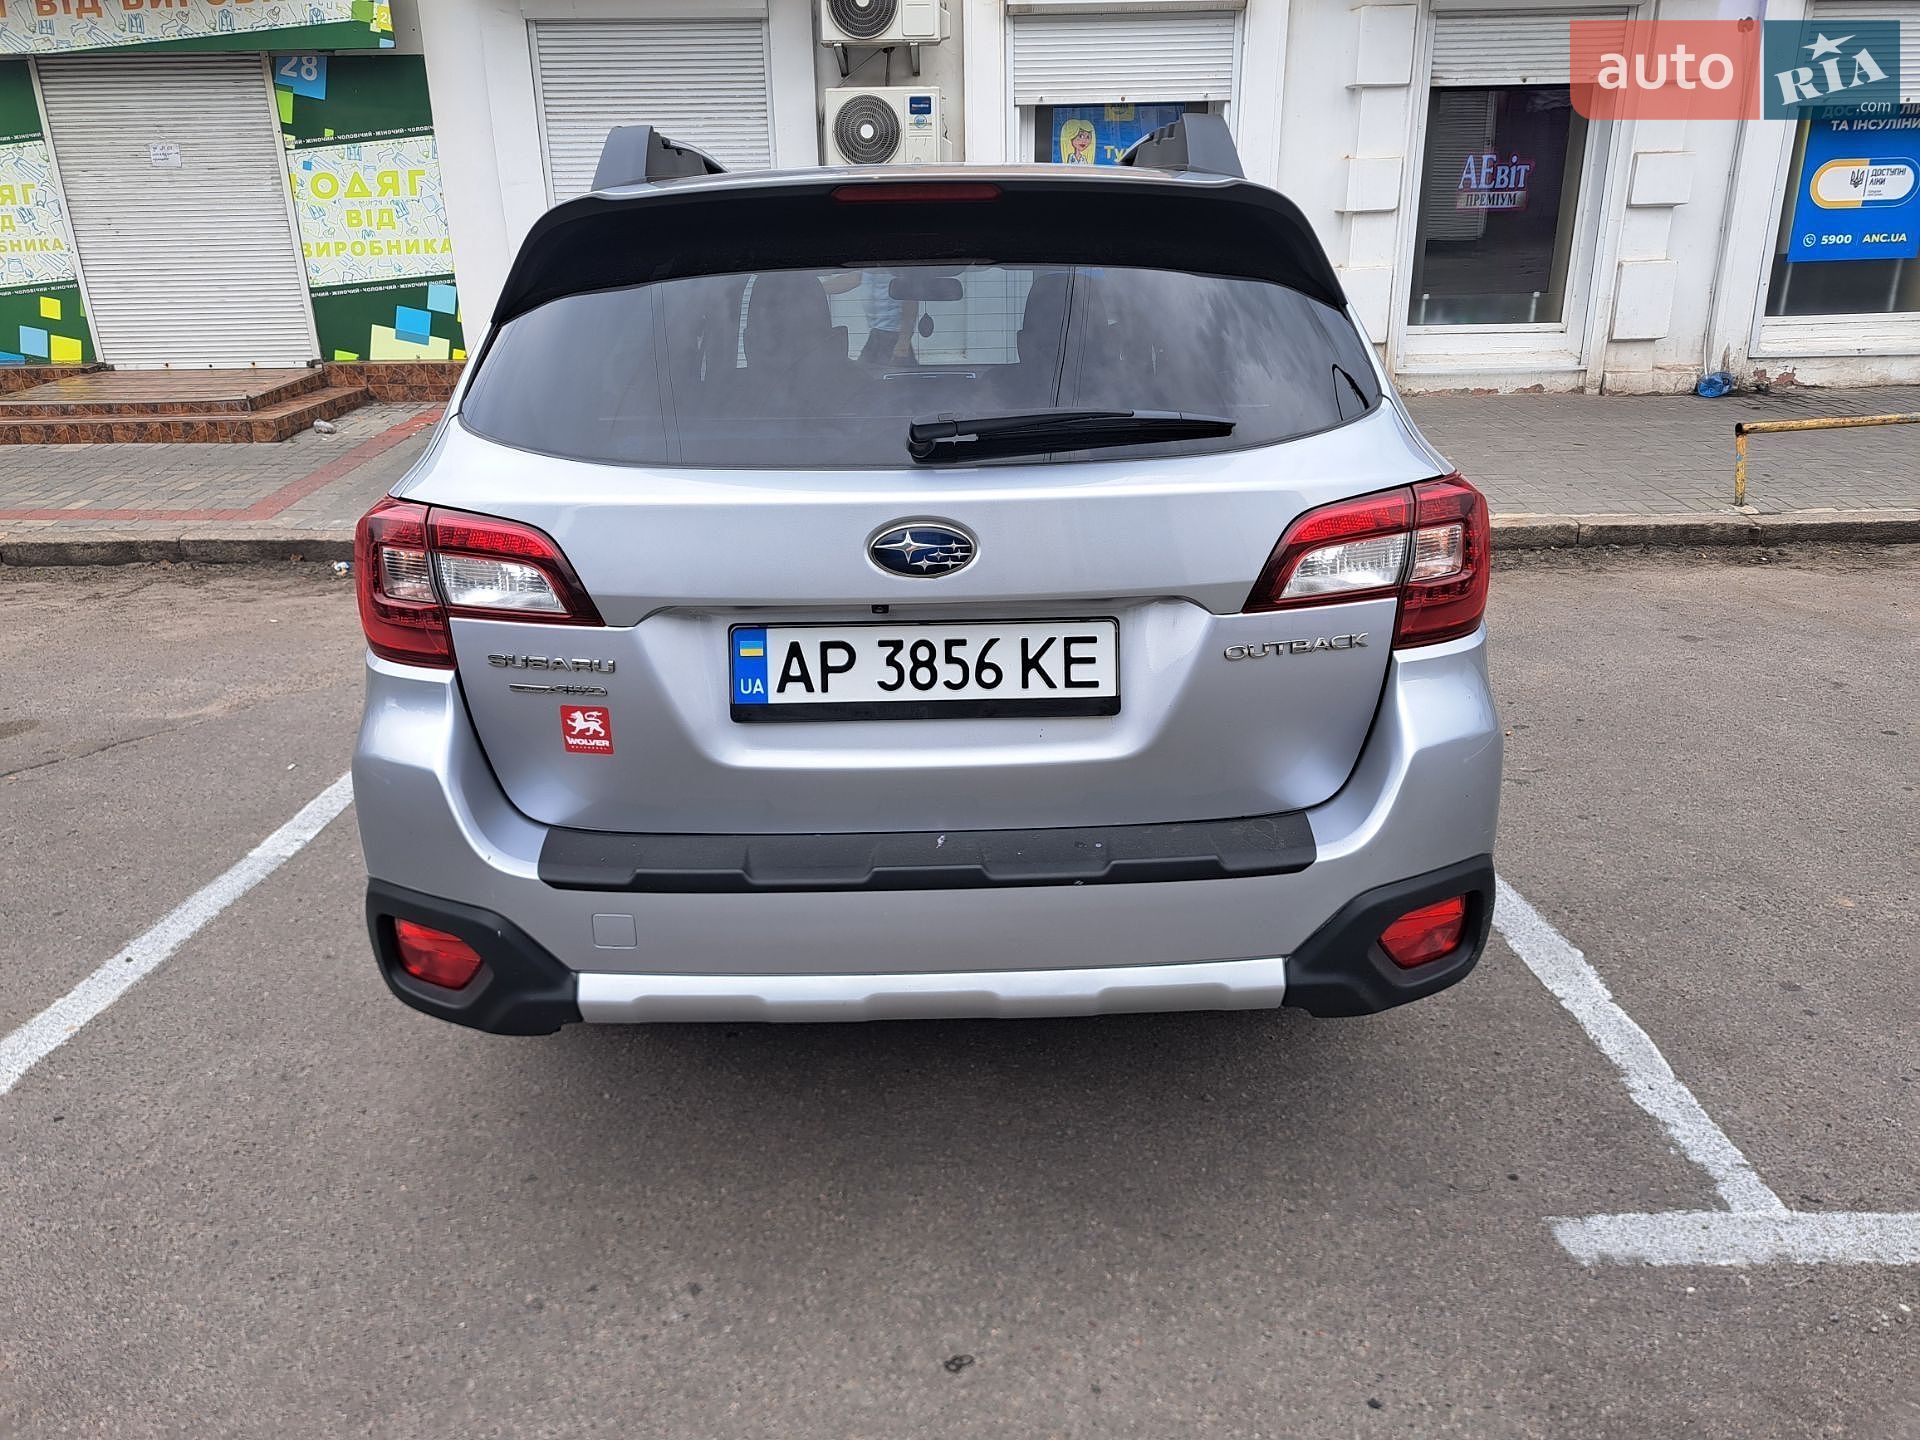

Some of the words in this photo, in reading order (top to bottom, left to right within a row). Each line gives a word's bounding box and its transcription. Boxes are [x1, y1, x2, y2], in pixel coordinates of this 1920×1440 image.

[280, 56, 318, 81] 28
[1831, 120, 1849, 131] ТА
[1870, 168, 1907, 177] ДОСТУПНІ
[310, 169, 426, 199] ОДЯГ
[1465, 193, 1517, 206] ПРЕМІУМ
[345, 208, 397, 230] ВІД
[1821, 235, 1852, 244] 5900
[1862, 233, 1907, 243] ANC.UA
[1224, 632, 1368, 661] OUTBACK
[488, 654, 615, 673] SUBARU
[776, 641, 857, 693] AP
[877, 637, 1003, 692] 3856
[1021, 636, 1099, 689] KE
[740, 678, 764, 694] UA
[566, 736, 610, 747] WOLVER
